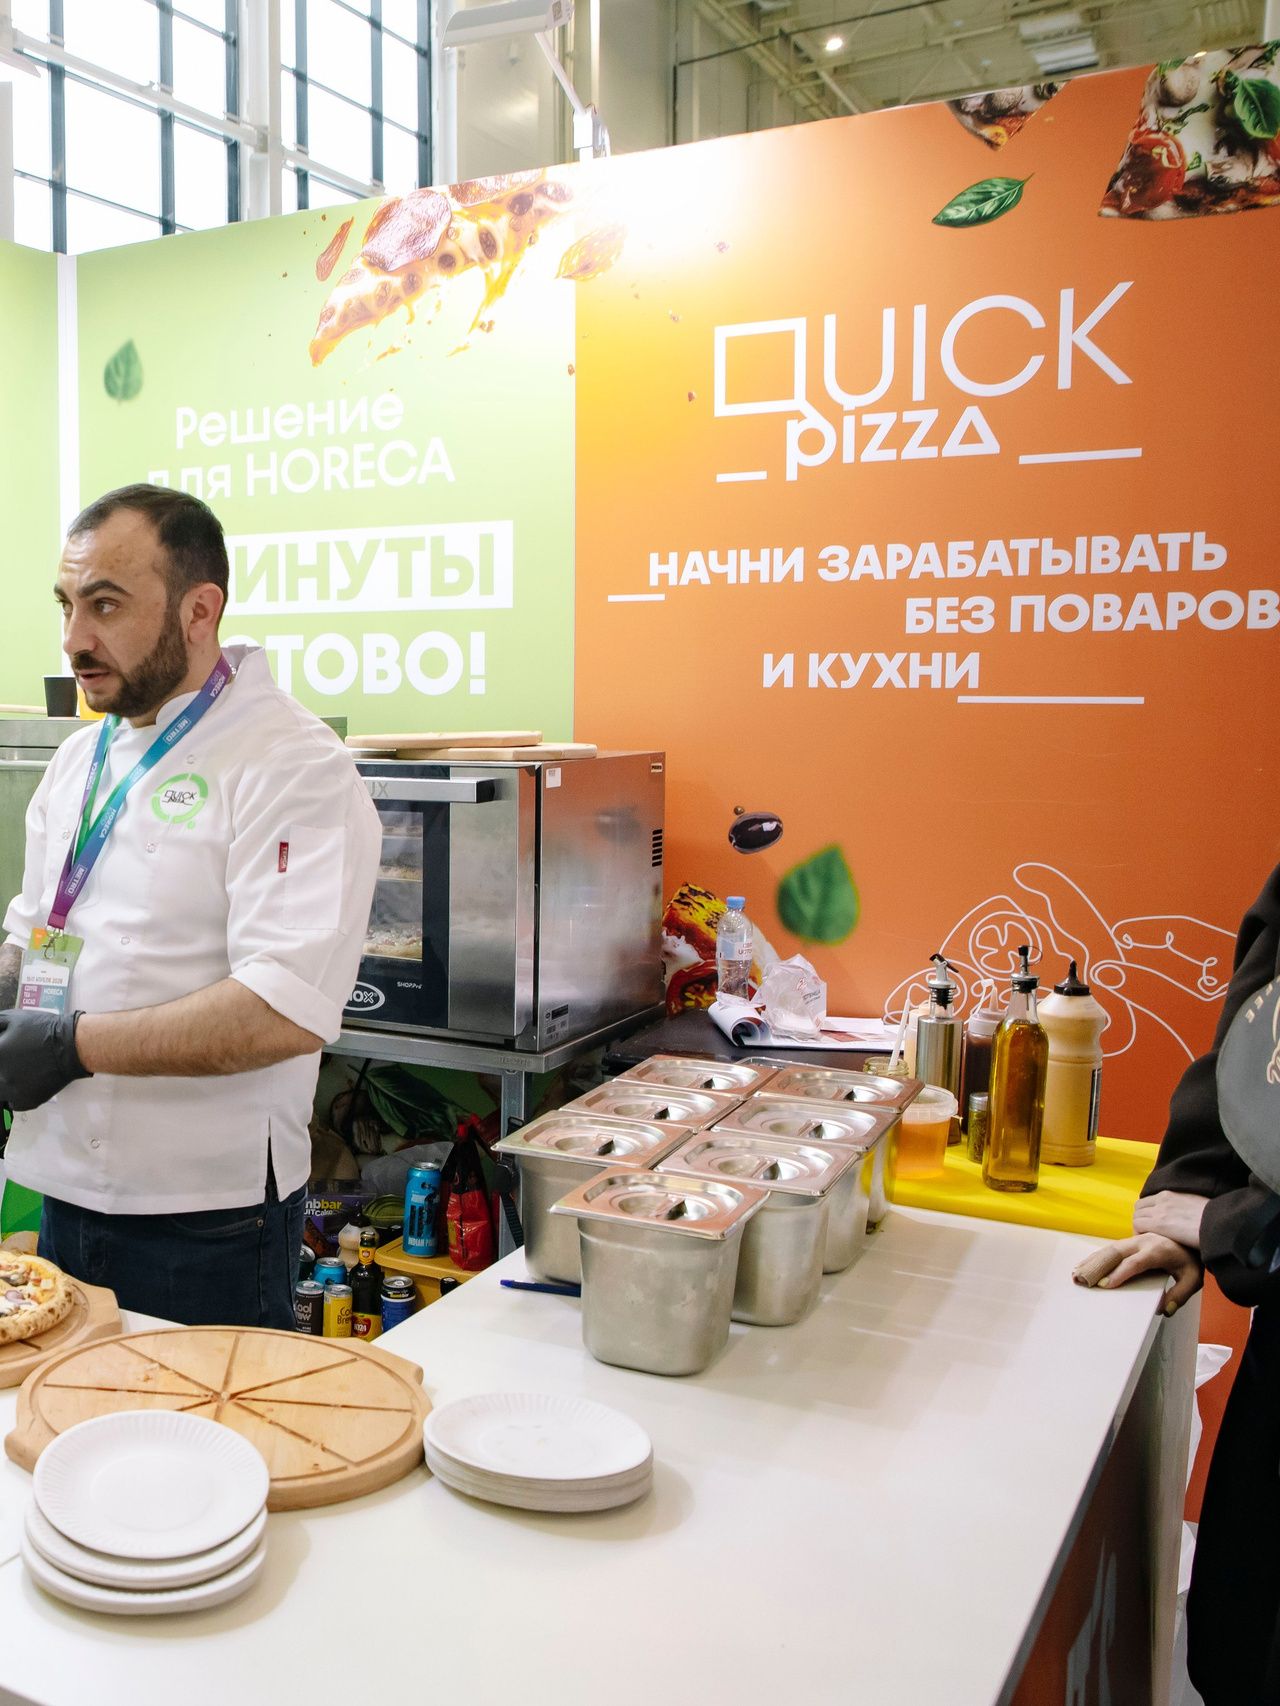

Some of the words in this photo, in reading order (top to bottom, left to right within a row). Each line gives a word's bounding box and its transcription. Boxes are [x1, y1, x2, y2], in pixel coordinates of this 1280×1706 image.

[714, 281, 1134, 420] QUICK
[175, 393, 405, 450] Решение
[246, 437, 456, 497] HORECA
[234, 533, 495, 604] ИНУТЫ
[649, 547, 805, 587] НАЧНИ
[817, 531, 1228, 582] ЗАРАБАТЫВАТЬ
[905, 595, 995, 634] БЕЗ
[1010, 589, 1280, 633] ПОВАРОВ
[221, 630, 486, 696] ТОВО!
[762, 652, 794, 688] И
[807, 651, 981, 689] КУХНИ
[166, 716, 189, 744] METRO
[98, 808, 117, 839] HORECA
[66, 867, 85, 894] METRO
